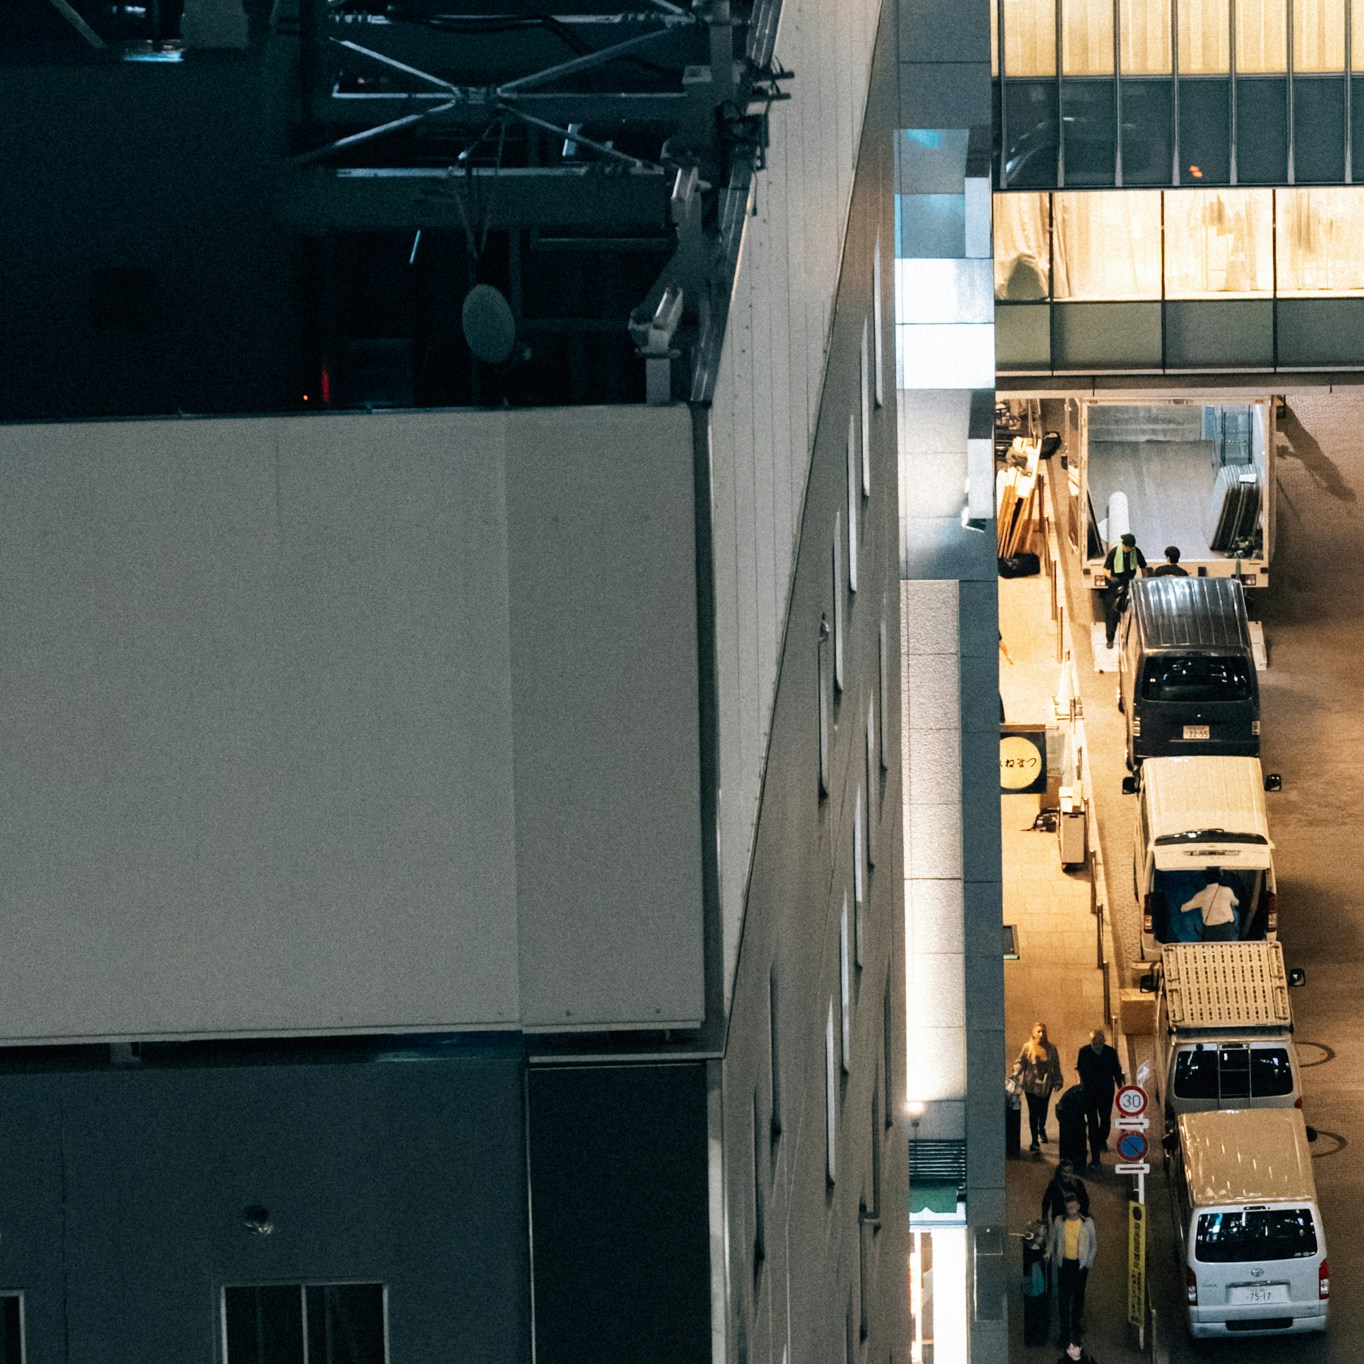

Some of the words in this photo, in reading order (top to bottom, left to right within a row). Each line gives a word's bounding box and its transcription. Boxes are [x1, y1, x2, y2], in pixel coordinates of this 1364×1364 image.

[1000, 757, 1037, 768] ねまつ
[1123, 1094, 1141, 1108] 30
